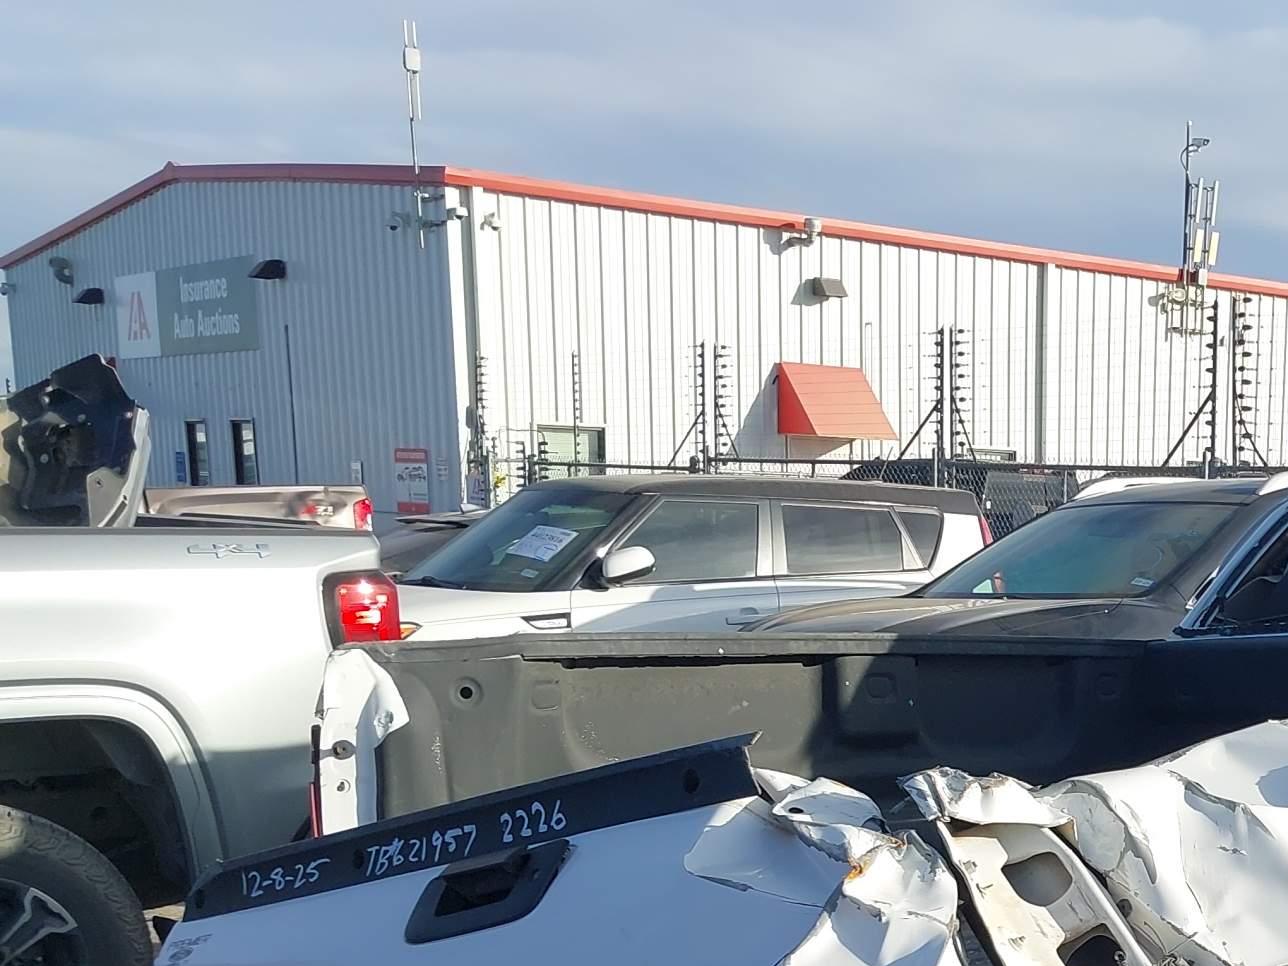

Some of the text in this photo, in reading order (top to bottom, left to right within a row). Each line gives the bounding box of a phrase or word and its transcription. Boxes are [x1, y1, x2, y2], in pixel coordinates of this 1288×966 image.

[179, 276, 228, 303] Insurance
[174, 308, 241, 341] Auto Auctions
[241, 857, 332, 897] 12-8-25
[499, 799, 568, 843] 2226
